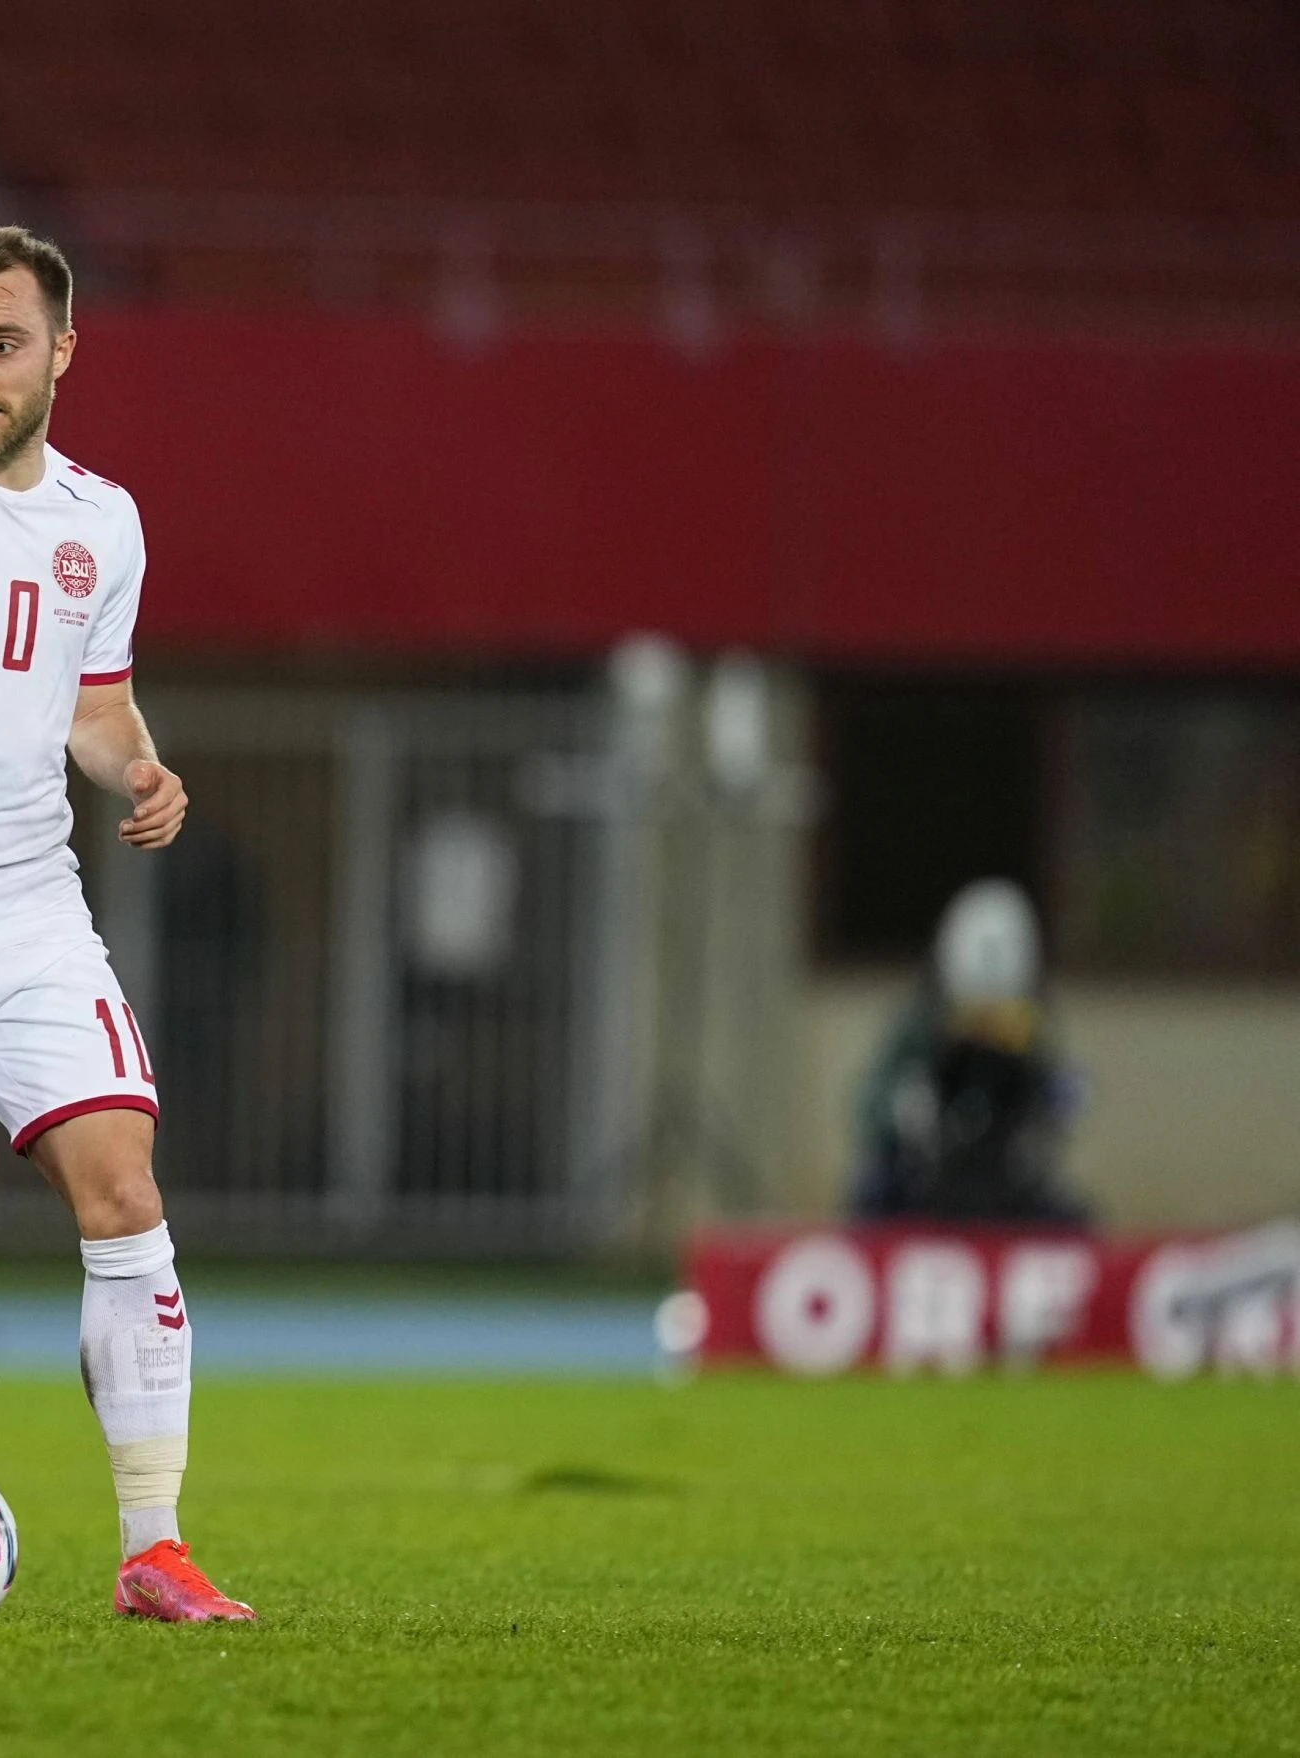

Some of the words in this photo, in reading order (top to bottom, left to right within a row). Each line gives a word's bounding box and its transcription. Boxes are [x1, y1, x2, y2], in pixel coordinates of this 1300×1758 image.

[61, 559, 89, 578] DBU
[89, 562, 97, 591] UNION
[67, 589, 87, 598] 1889
